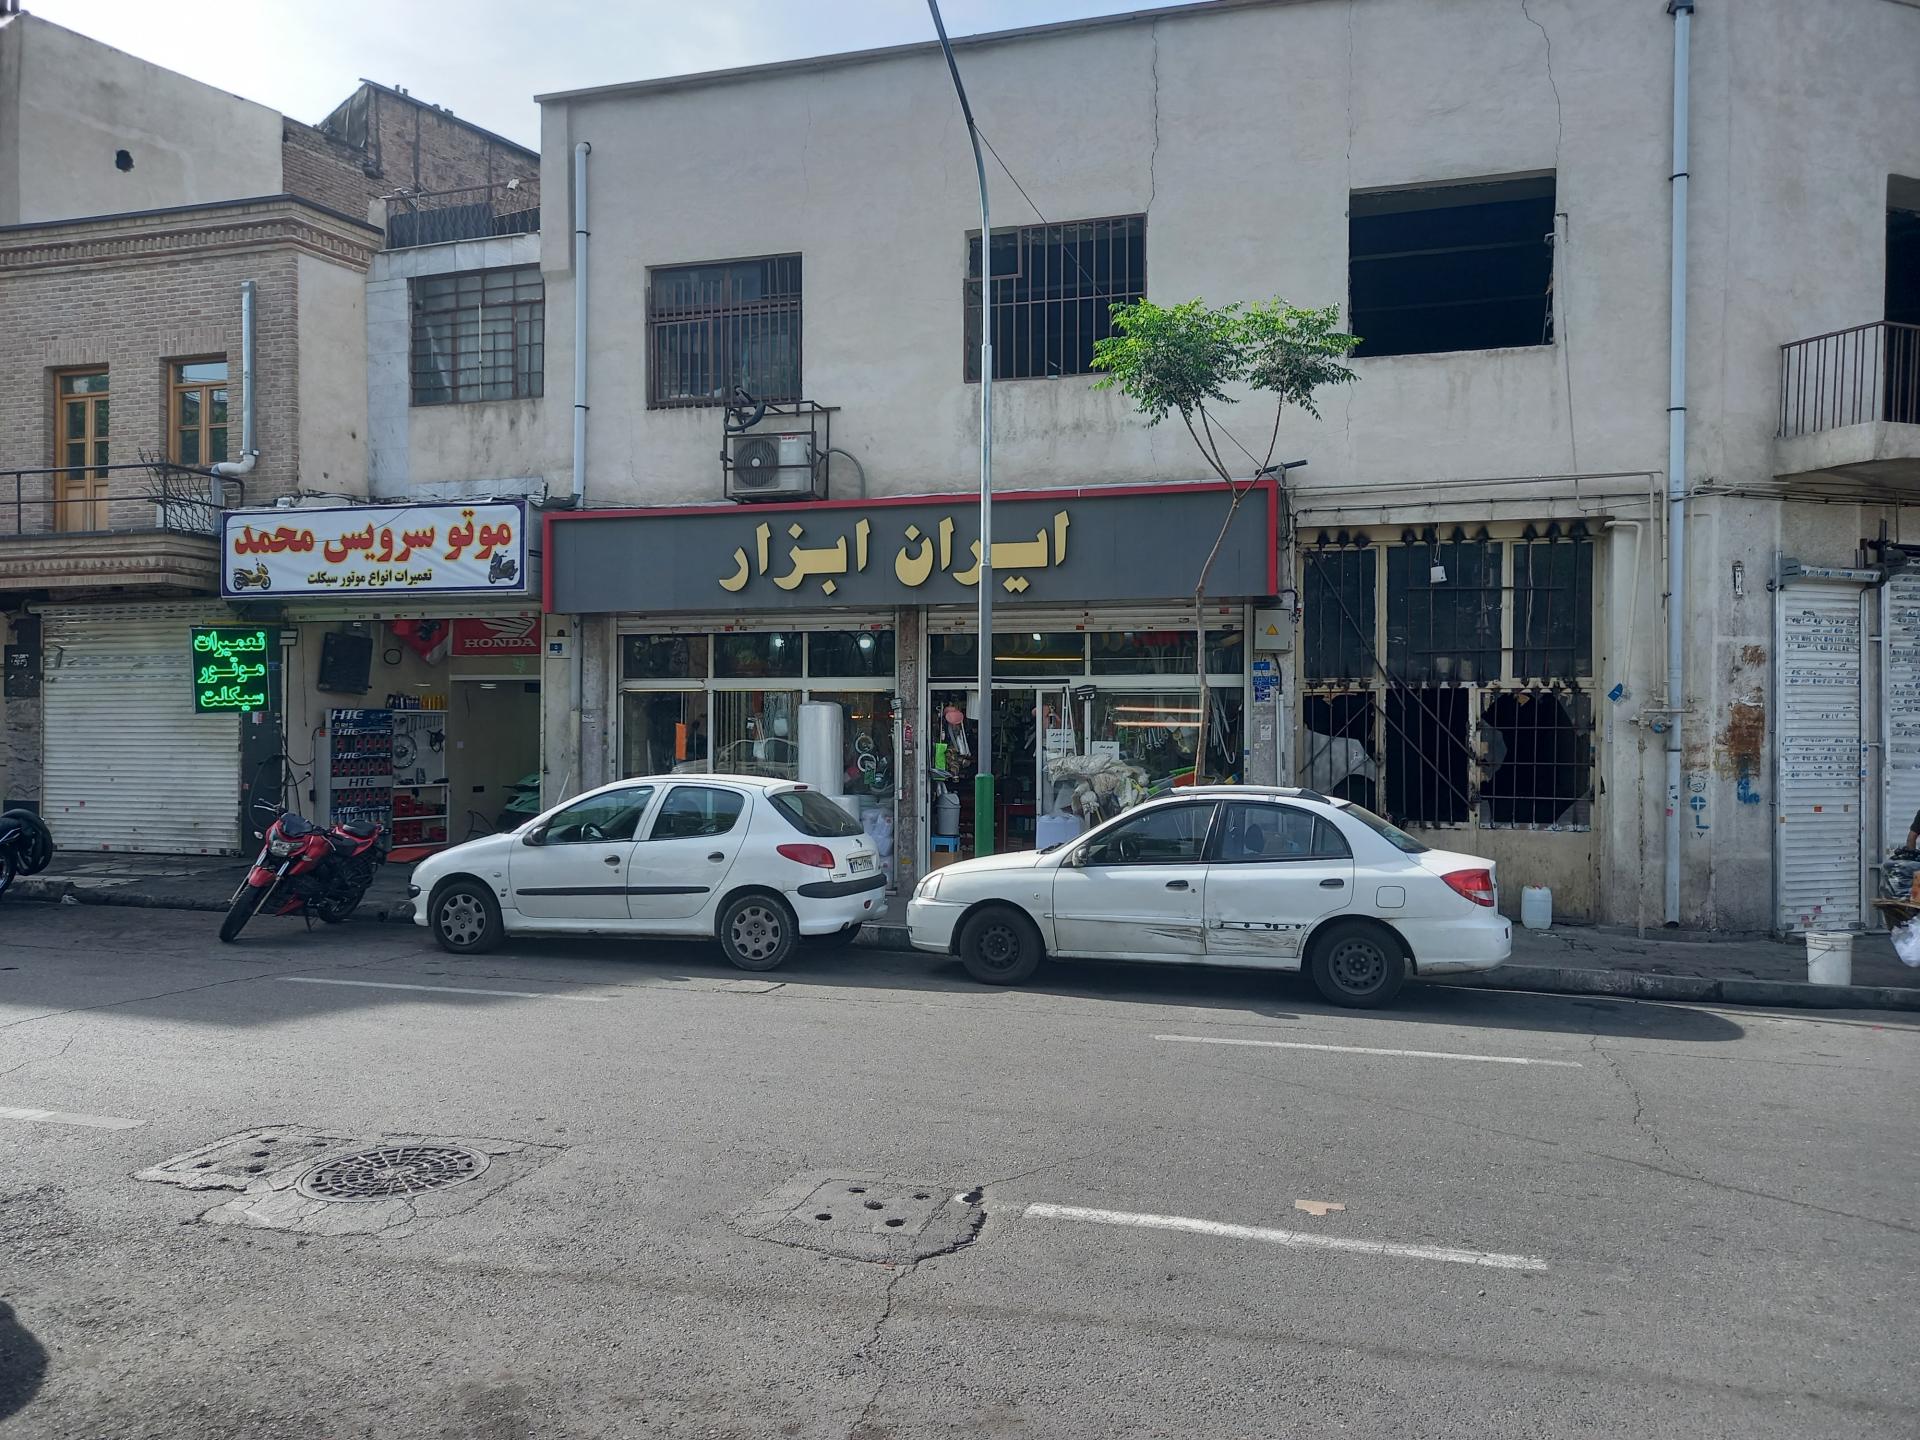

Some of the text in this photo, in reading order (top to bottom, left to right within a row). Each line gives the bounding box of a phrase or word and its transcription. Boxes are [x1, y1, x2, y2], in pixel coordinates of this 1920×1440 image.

[234, 509, 513, 564] موتو سرویس محمد
[718, 509, 1071, 597] ایران ابزار
[307, 569, 433, 587] تعمیرات انواع موتور سیکلت
[194, 630, 266, 658] تعمیرات
[464, 638, 537, 648] HONDA
[197, 656, 266, 684] موتور
[200, 685, 265, 712] سیکلت
